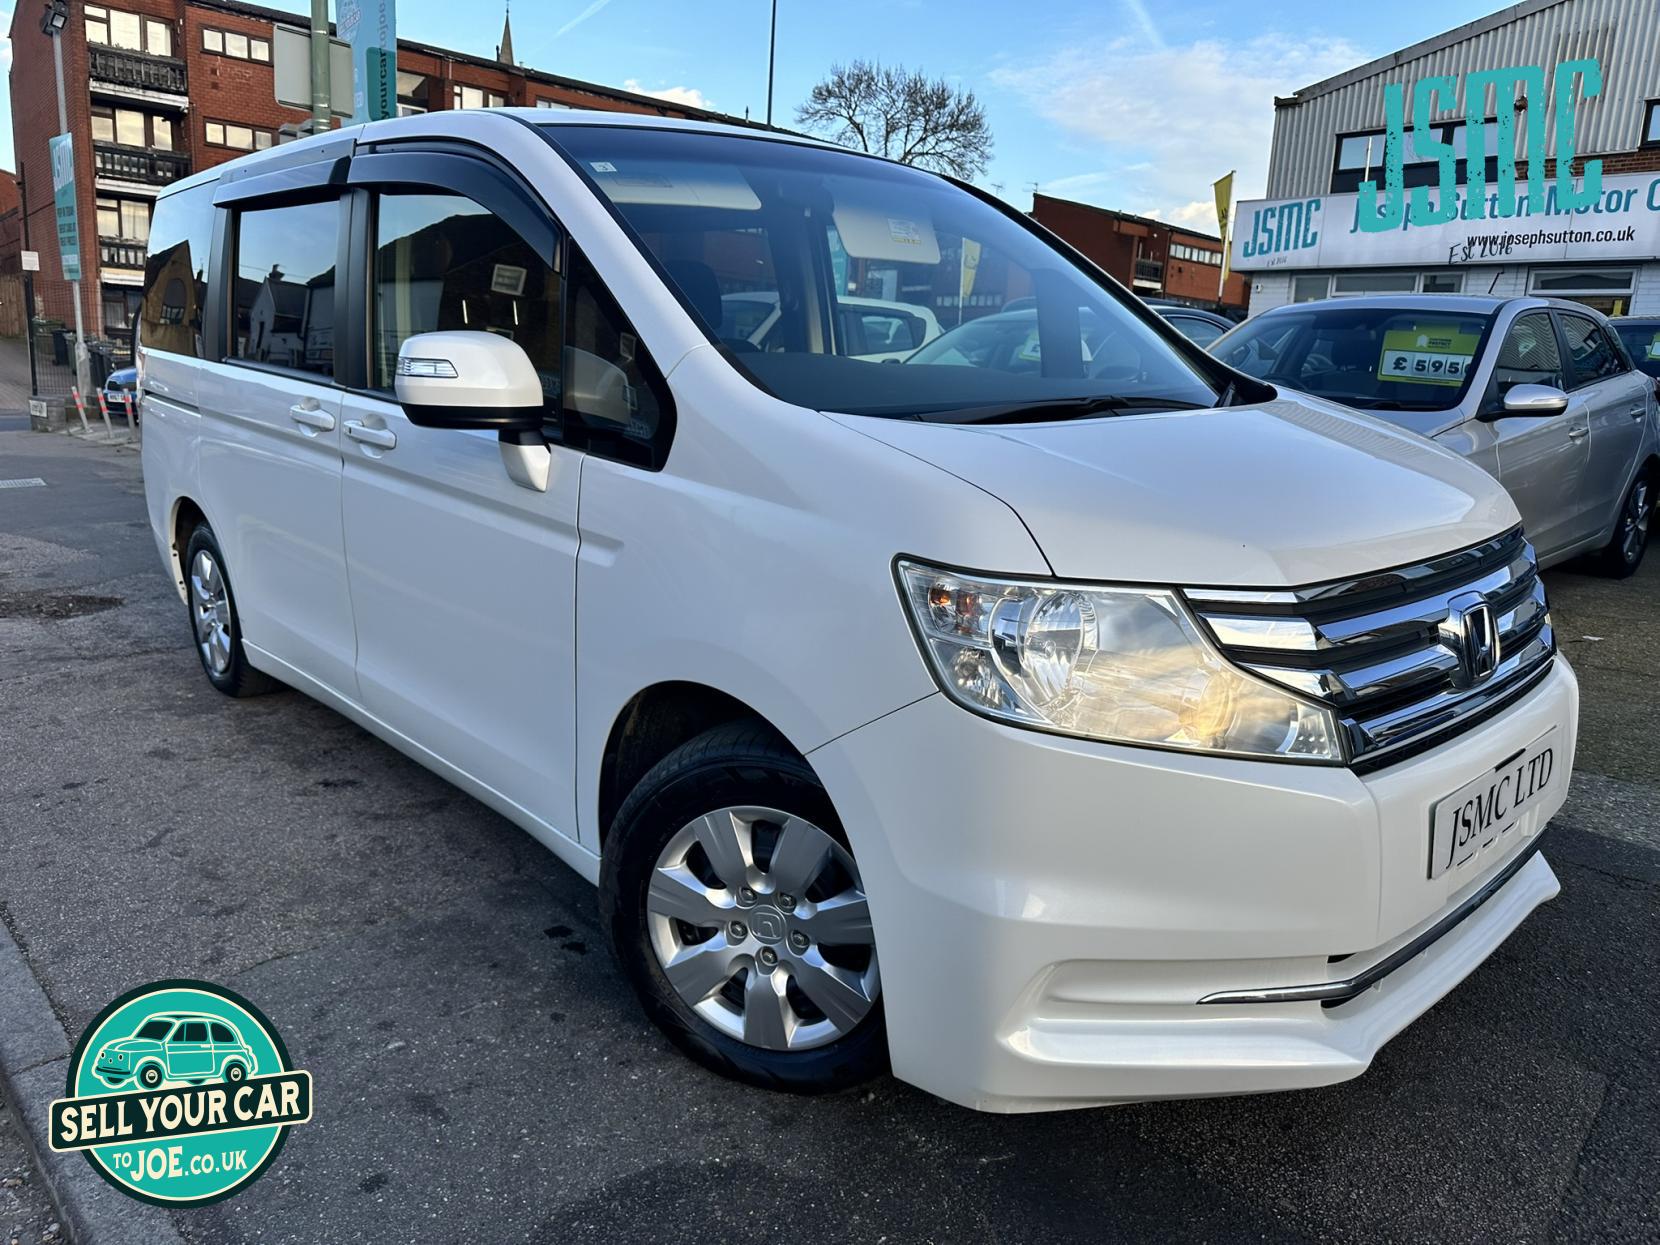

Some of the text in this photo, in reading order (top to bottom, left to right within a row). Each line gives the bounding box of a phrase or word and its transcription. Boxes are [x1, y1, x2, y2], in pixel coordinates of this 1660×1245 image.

[1243, 199, 1321, 258] JSMC
[1467, 226, 1635, 249] www.josephsutton.co.uk
[1446, 748, 1553, 869] JSMC LTD
